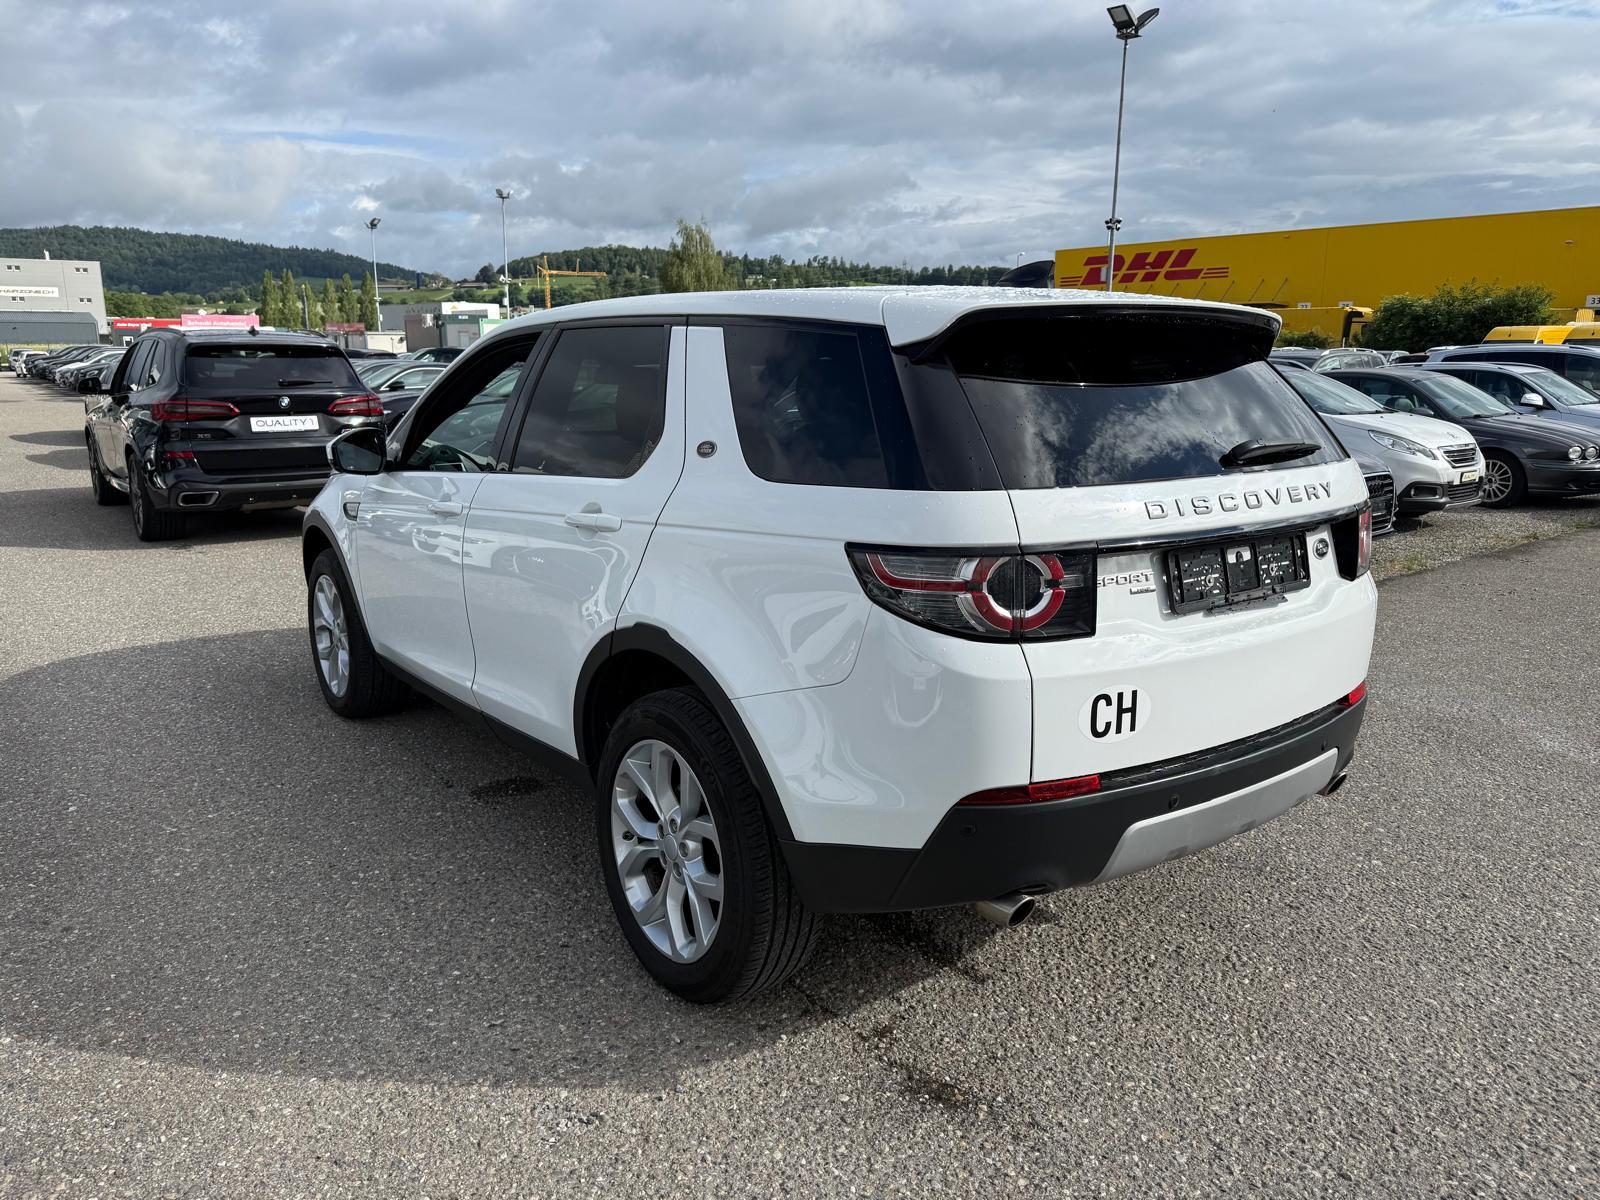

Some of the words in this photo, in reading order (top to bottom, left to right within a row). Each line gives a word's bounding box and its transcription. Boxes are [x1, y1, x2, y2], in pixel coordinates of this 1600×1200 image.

[1080, 248, 1204, 286] DHL
[1144, 481, 1332, 520] DISCOVERY
[1090, 689, 1138, 739] CH
